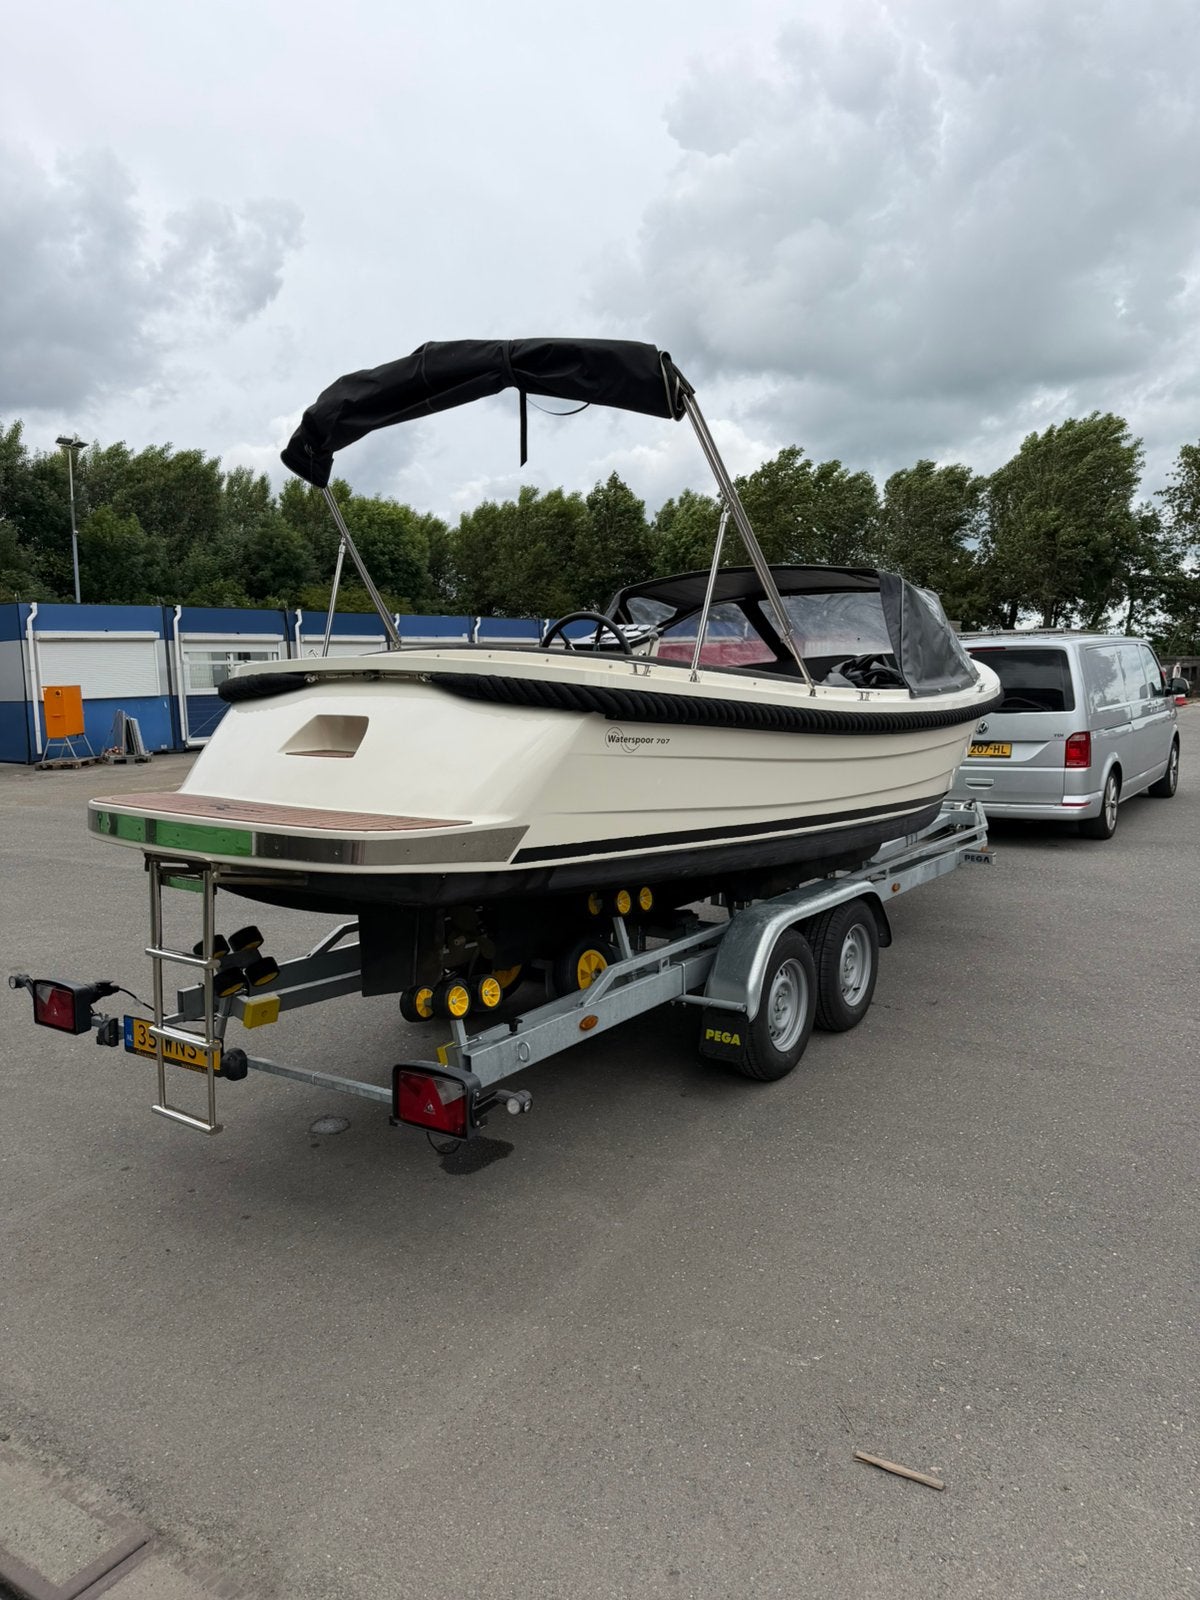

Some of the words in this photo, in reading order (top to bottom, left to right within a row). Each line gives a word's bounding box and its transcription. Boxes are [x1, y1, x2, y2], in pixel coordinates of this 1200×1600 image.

[608, 735, 654, 745] Waterspoor
[964, 854, 990, 863] PEGA
[705, 1029, 741, 1046] PEGA
